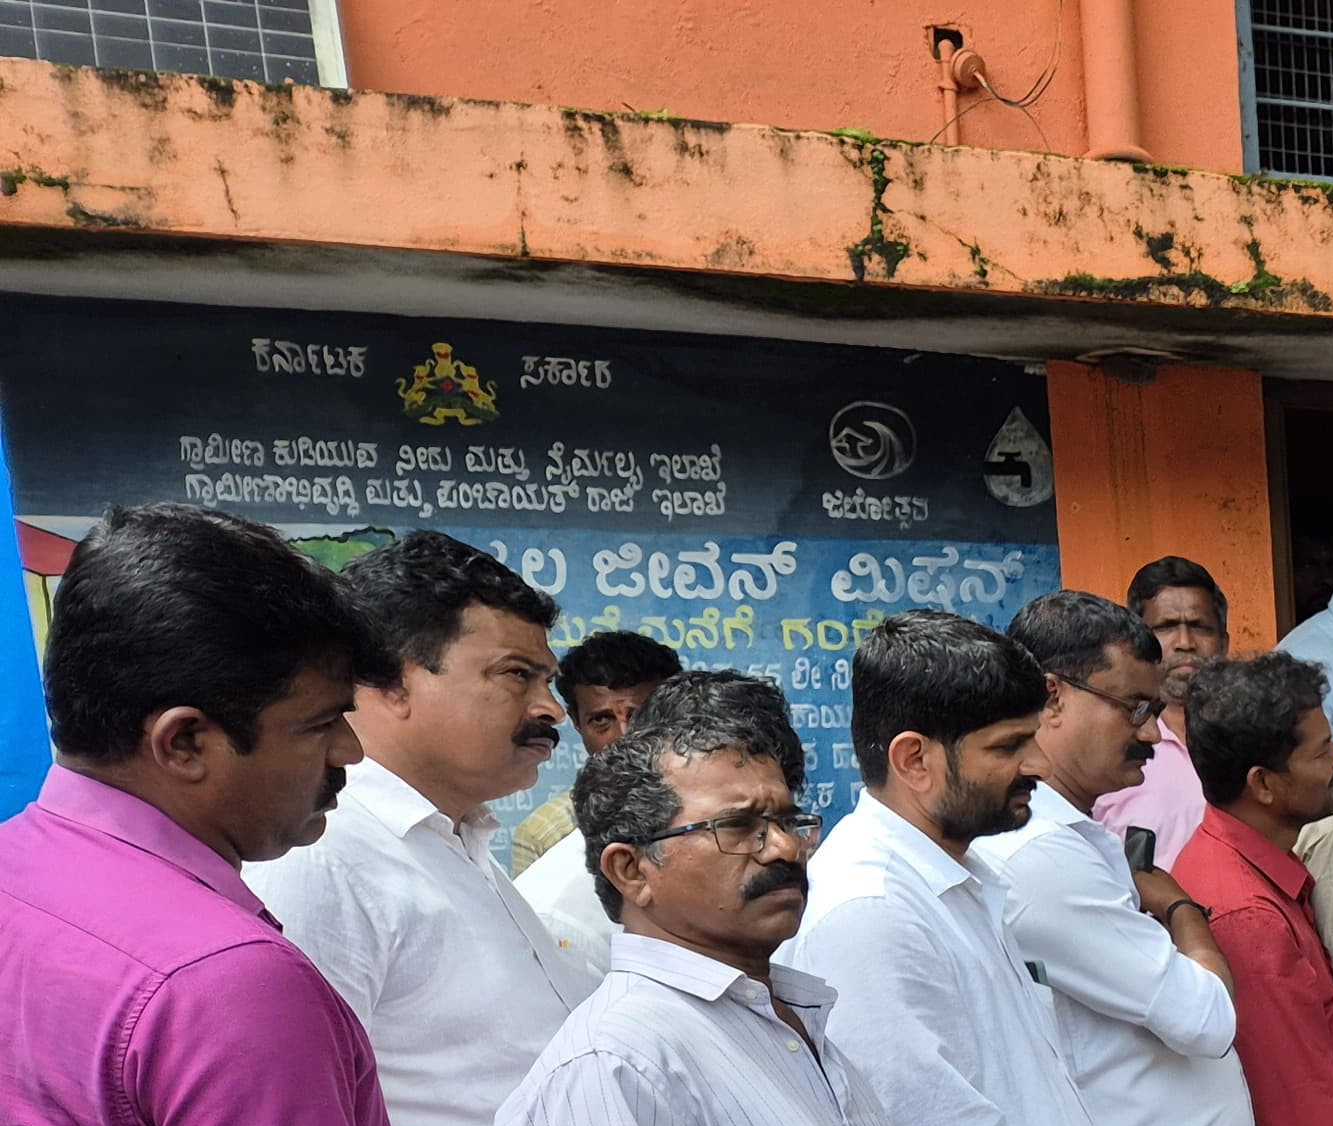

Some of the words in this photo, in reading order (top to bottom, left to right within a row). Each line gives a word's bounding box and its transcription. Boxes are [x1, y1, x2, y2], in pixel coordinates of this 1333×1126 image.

[252, 338, 368, 378] ಕರ್ನಾಟಕ
[520, 355, 613, 389] ಸರ್ಕಾರ
[272, 436, 378, 468] ಕುಡಿಯುವ
[395, 444, 451, 476] ನೀರು
[465, 445, 530, 481] ಮತ್ತು
[650, 444, 722, 484] ಇಲಾಖೆ
[365, 478, 433, 519] ಮತ್ತು
[651, 481, 726, 522] ಇಲಾಖೆ
[592, 541, 798, 600] ಜೀವನ್
